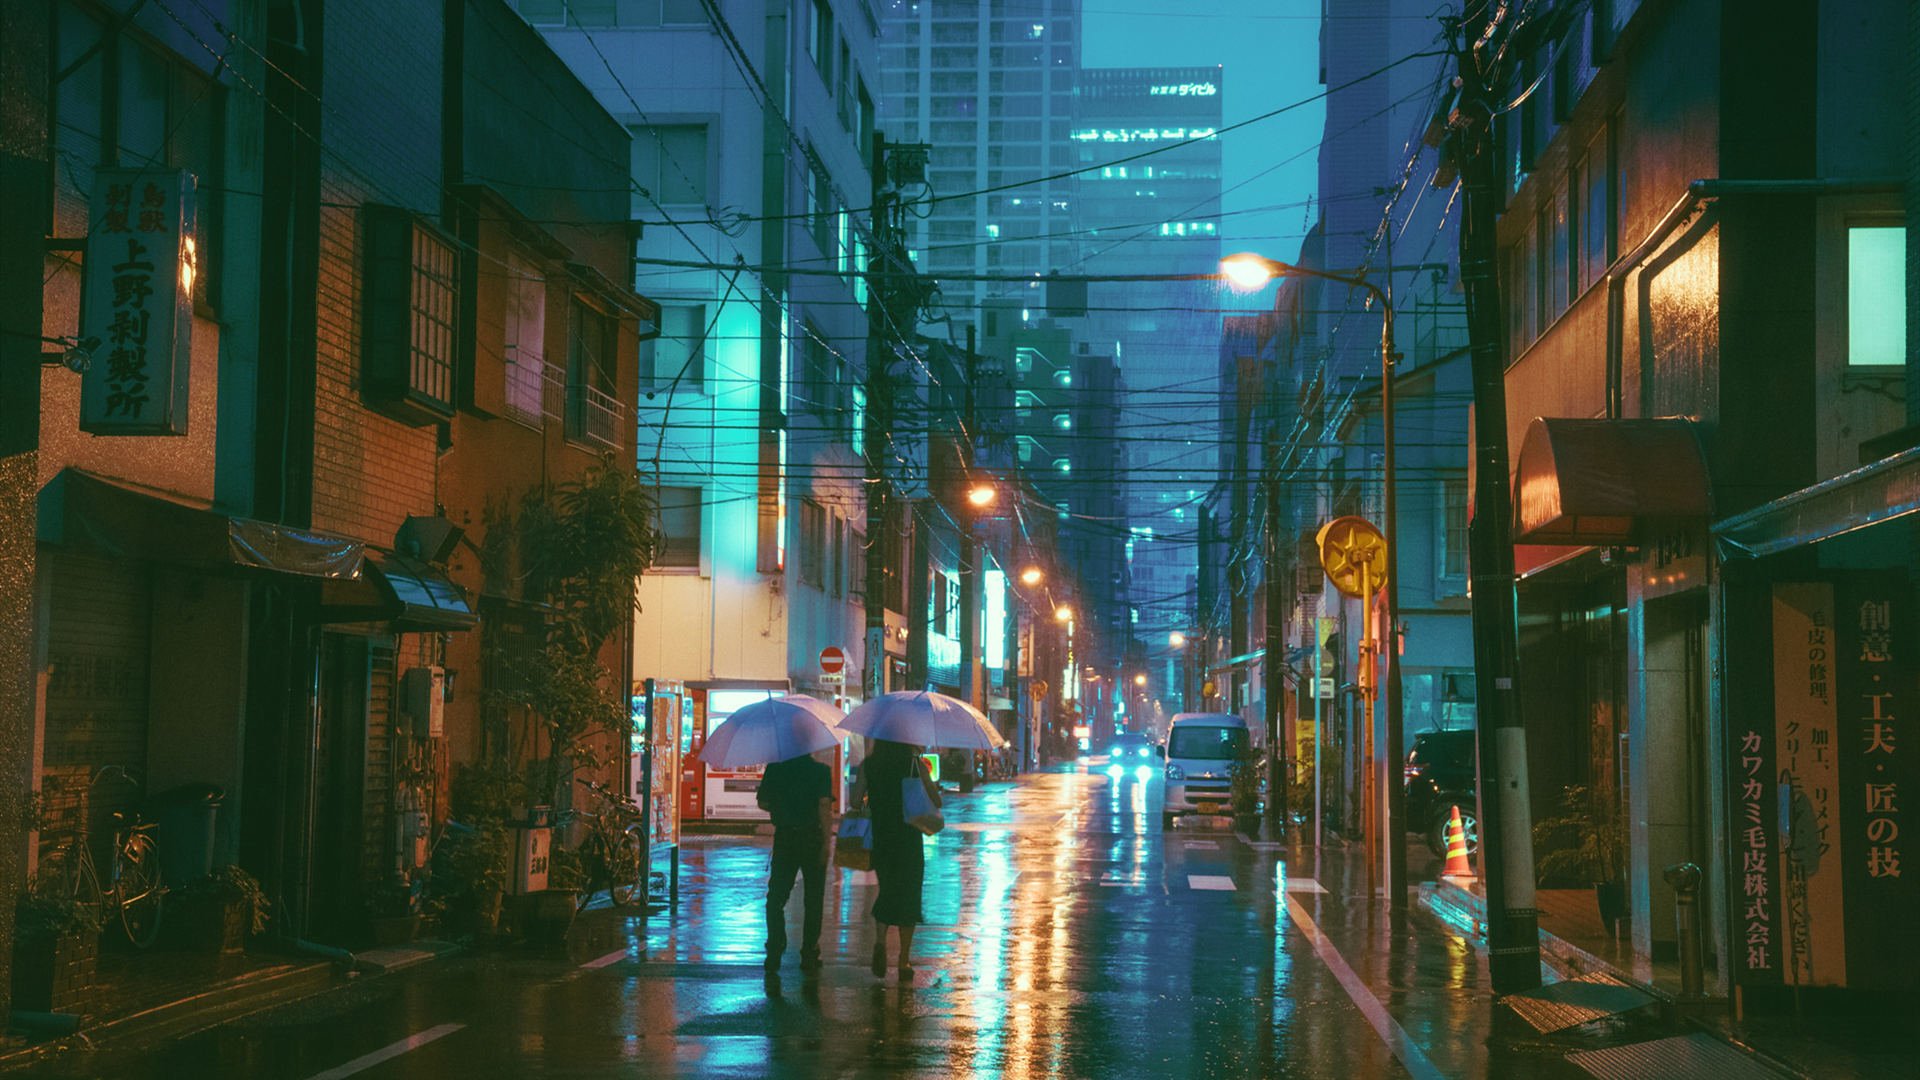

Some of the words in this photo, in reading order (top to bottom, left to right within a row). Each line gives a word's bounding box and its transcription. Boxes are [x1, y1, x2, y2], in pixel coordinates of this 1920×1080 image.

[1740, 730, 1772, 970] カワカミ毛皮株式会社
[1814, 788, 1831, 857] リメイク
[1858, 599, 1903, 880] 創意・工夫・匠の技
